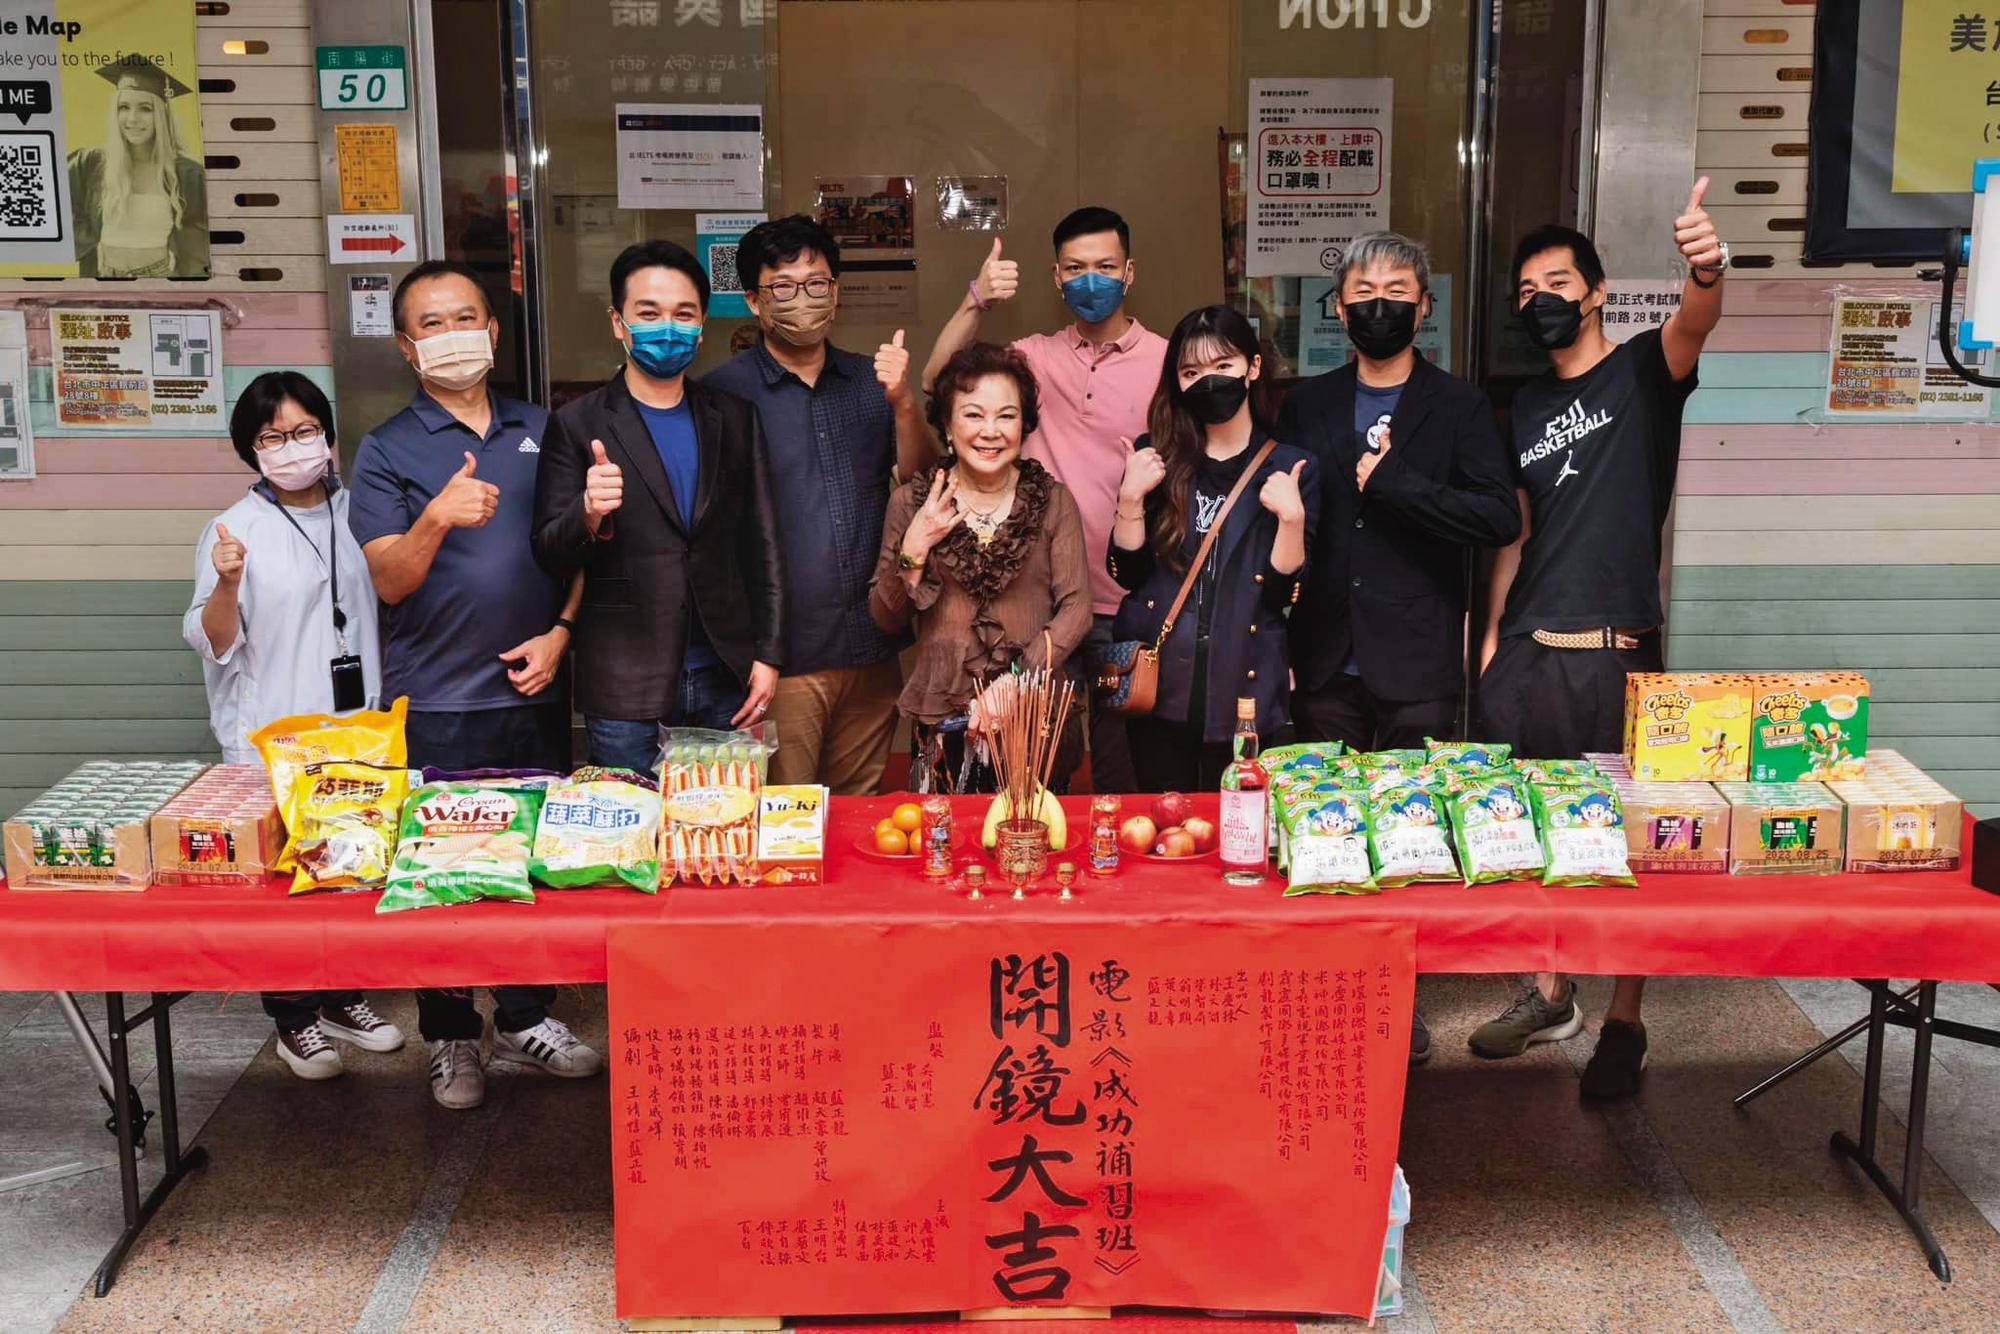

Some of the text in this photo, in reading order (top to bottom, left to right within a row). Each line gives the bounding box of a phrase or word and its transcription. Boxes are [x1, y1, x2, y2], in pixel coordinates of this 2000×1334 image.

[26, 15, 81, 42] Map
[1949, 14, 2000, 52] 美
[27, 55, 57, 70] you
[62, 54, 79, 66] to
[84, 52, 110, 66] the
[115, 52, 164, 66] future
[9, 89, 35, 105] ME
[338, 74, 386, 103] 50
[1266, 150, 1374, 168] 務必全程配戴
[1633, 313, 1646, 323] 28
[1649, 312, 1662, 323] 號
[1520, 408, 1614, 468] BASKETBALL
[1645, 692, 1690, 710] Cheetos
[1760, 692, 1806, 710] Cheetos
[412, 806, 516, 823] Wafer
[766, 801, 817, 811] Yu-Ki
[1236, 968, 1250, 1015] 出品人
[1377, 963, 1392, 1040] 出品公司
[623, 1027, 641, 1067] 編劇
[829, 1023, 842, 1063] 導演
[973, 950, 1089, 1302] 開鏡大吉
[1080, 959, 1141, 1276] 電影《成功補習班》
